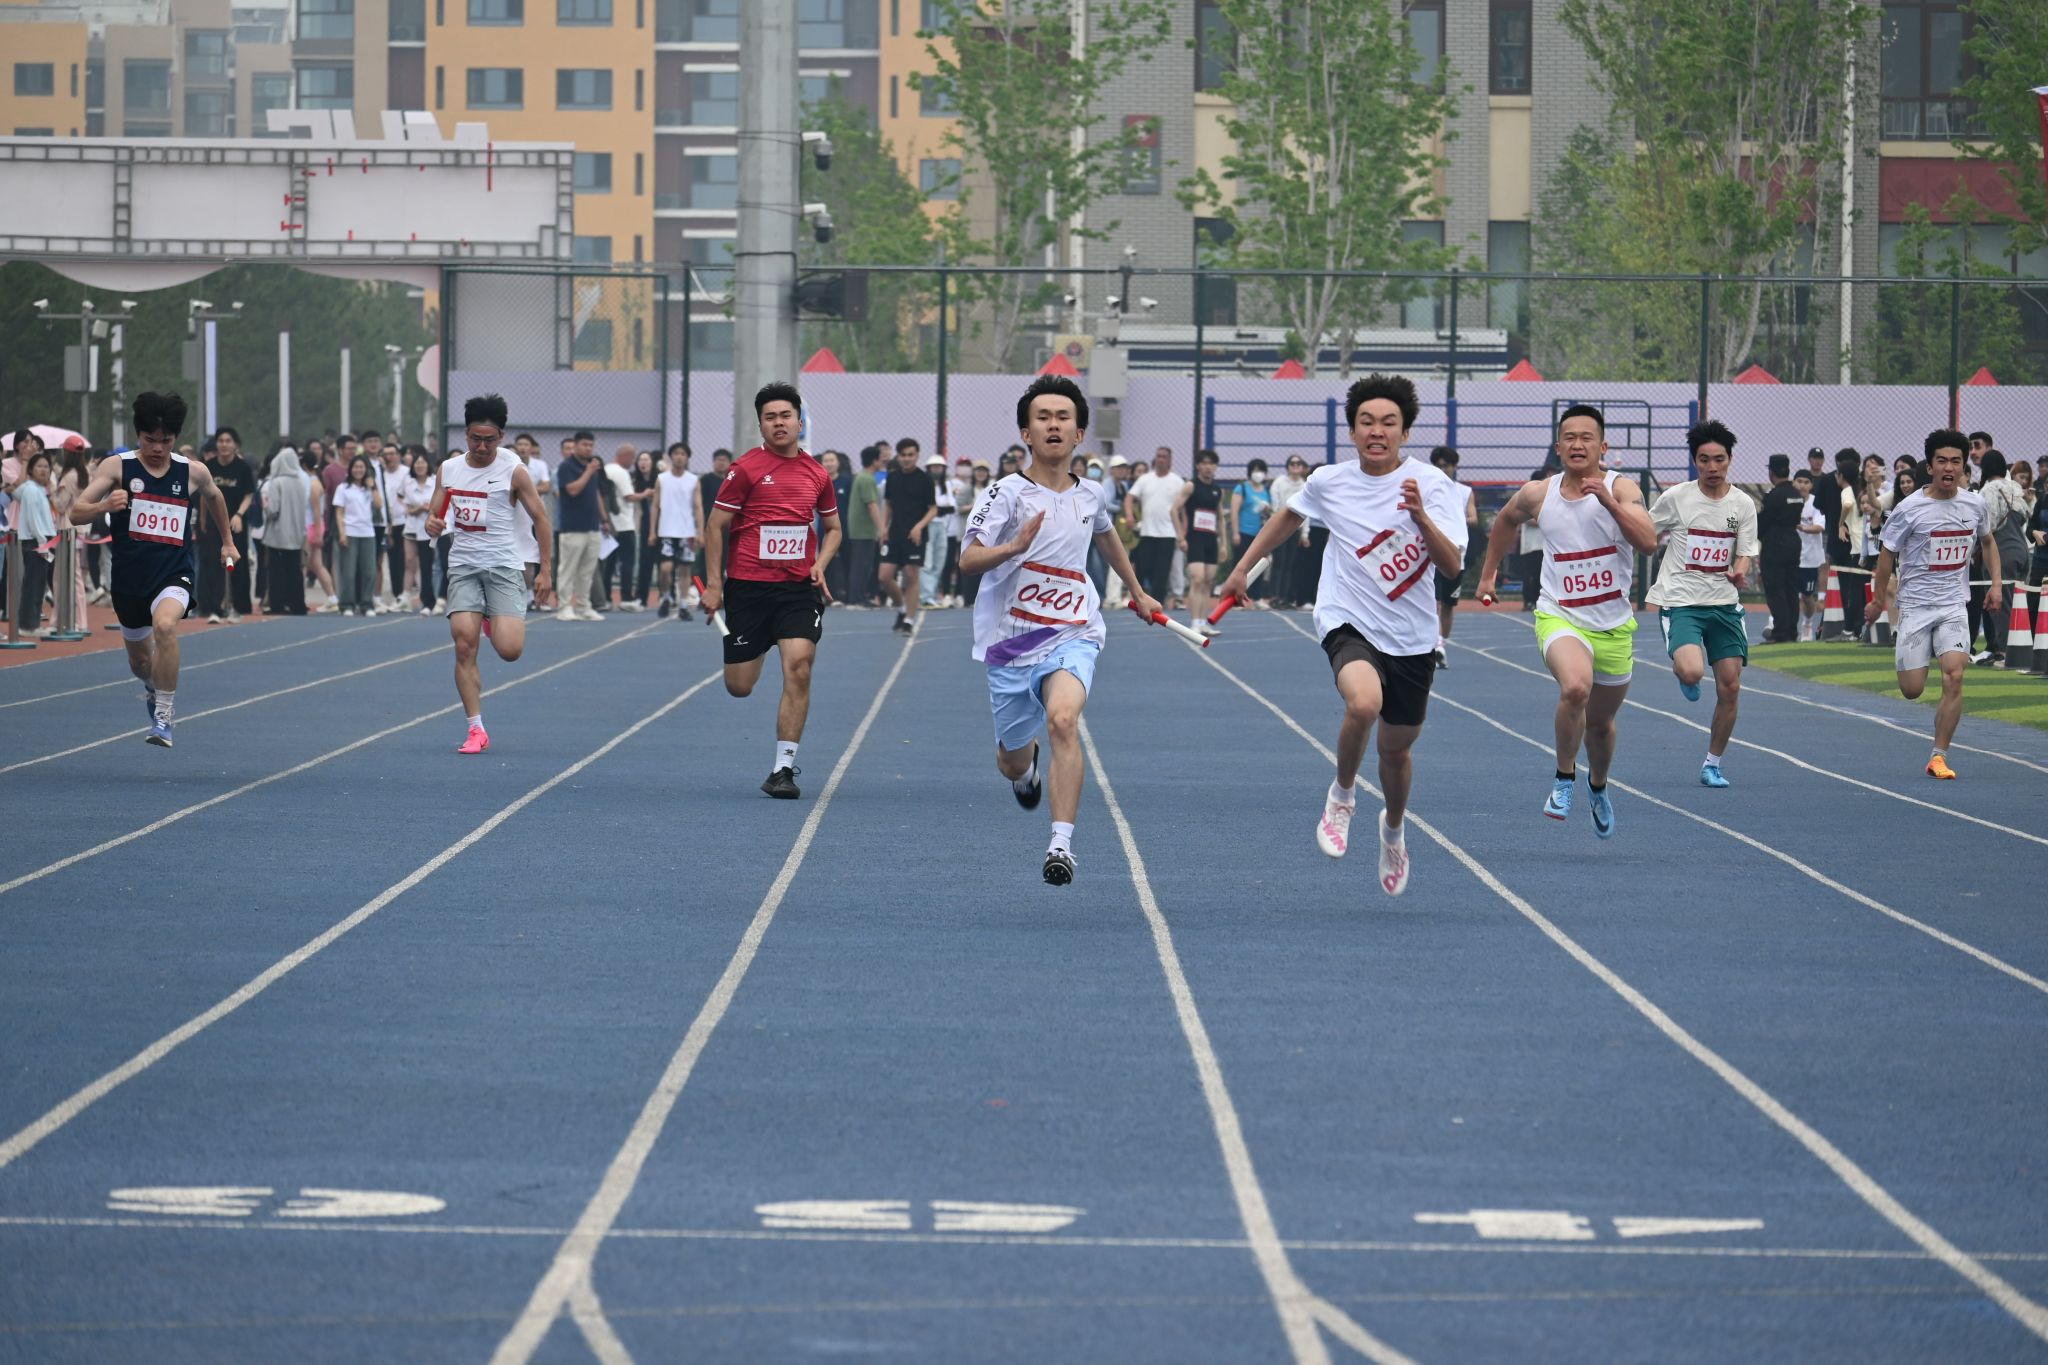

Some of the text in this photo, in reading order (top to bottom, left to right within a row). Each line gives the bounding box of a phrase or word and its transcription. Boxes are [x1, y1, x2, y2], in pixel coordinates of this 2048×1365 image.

[136, 512, 179, 533] 0910
[767, 538, 804, 554] 0224
[1692, 547, 1729, 562] 0749
[1936, 545, 1968, 561] 1717
[1563, 570, 1613, 593] 0549
[1018, 583, 1085, 615] 0401
